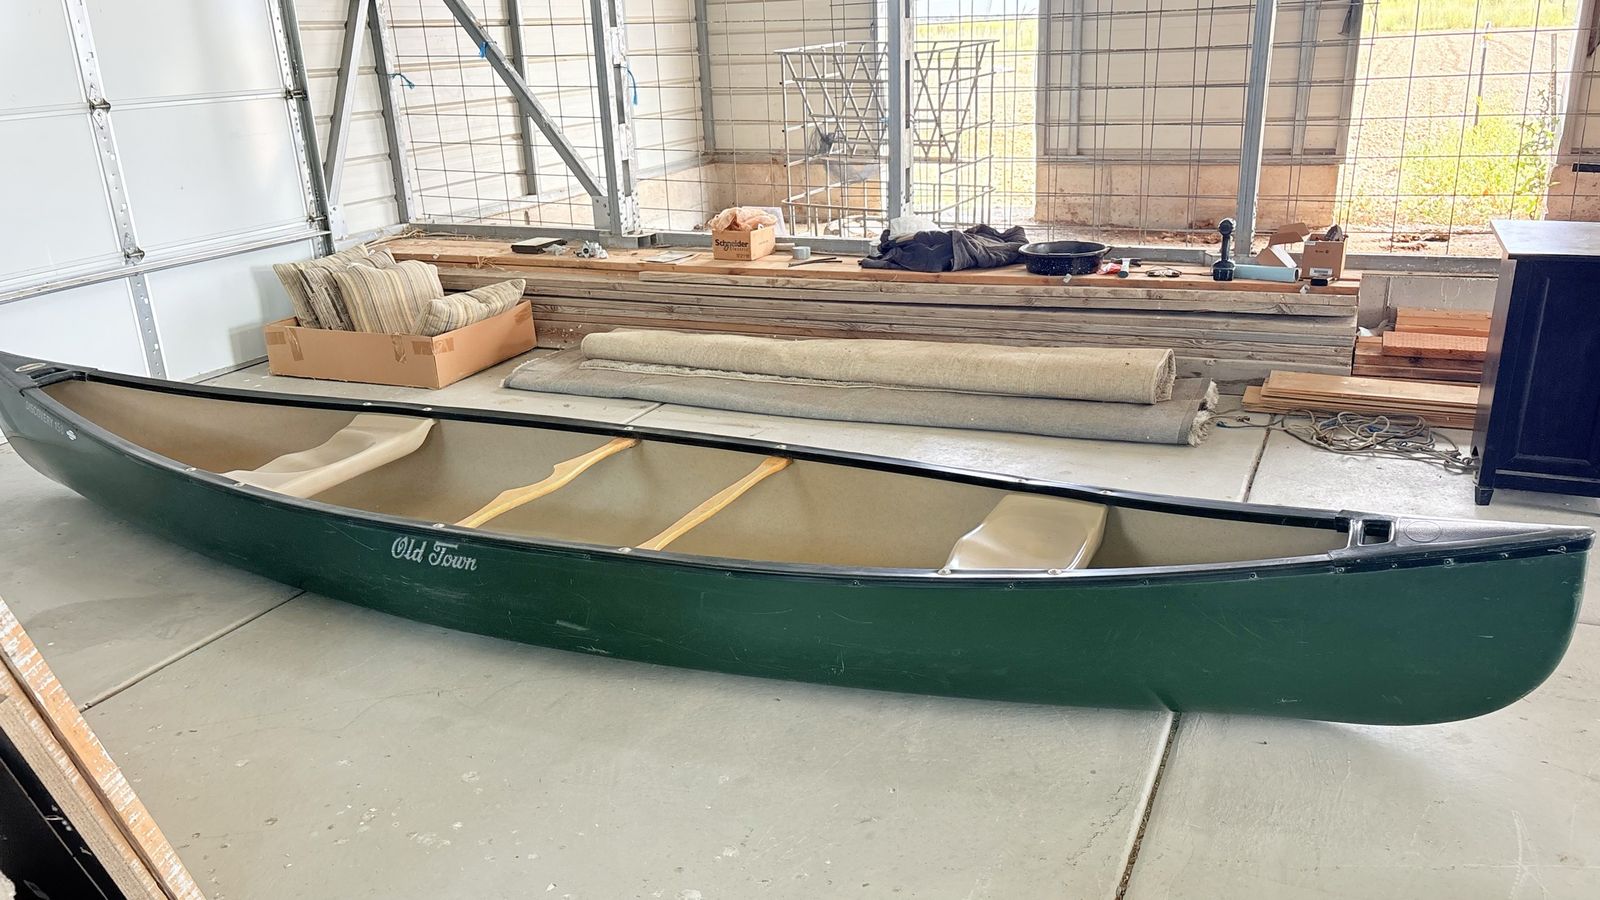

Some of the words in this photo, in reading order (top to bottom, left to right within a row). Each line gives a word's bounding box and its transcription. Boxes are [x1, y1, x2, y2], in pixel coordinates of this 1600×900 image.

[715, 238, 749, 252] Schneider
[391, 536, 427, 563] Old
[428, 541, 478, 571] Town
